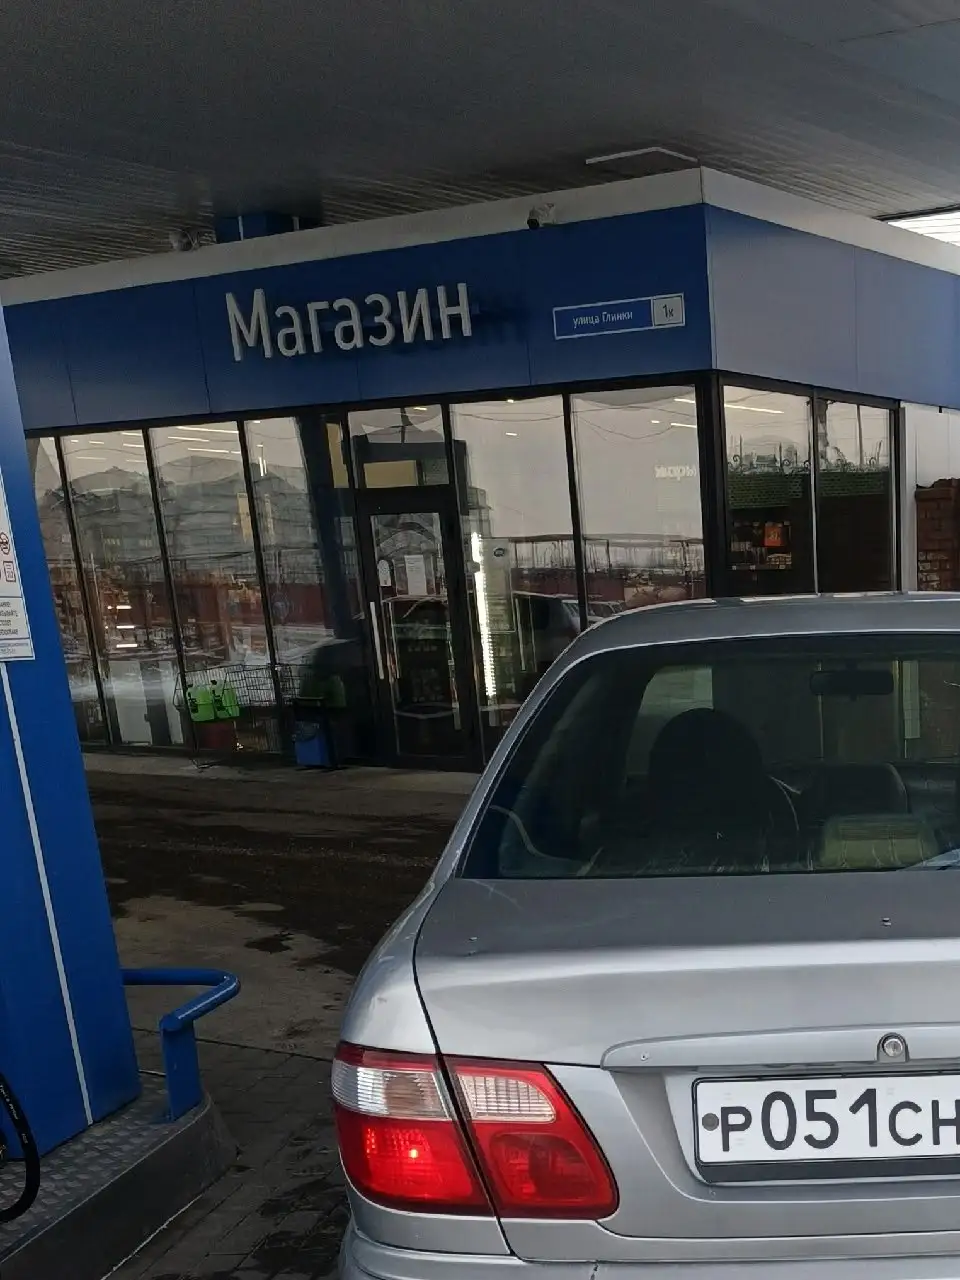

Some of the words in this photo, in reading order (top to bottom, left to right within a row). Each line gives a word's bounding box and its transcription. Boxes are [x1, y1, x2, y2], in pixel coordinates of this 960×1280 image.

[225, 282, 472, 361] Магазин
[573, 315, 600, 329] улица
[602, 311, 633, 322] Глинки
